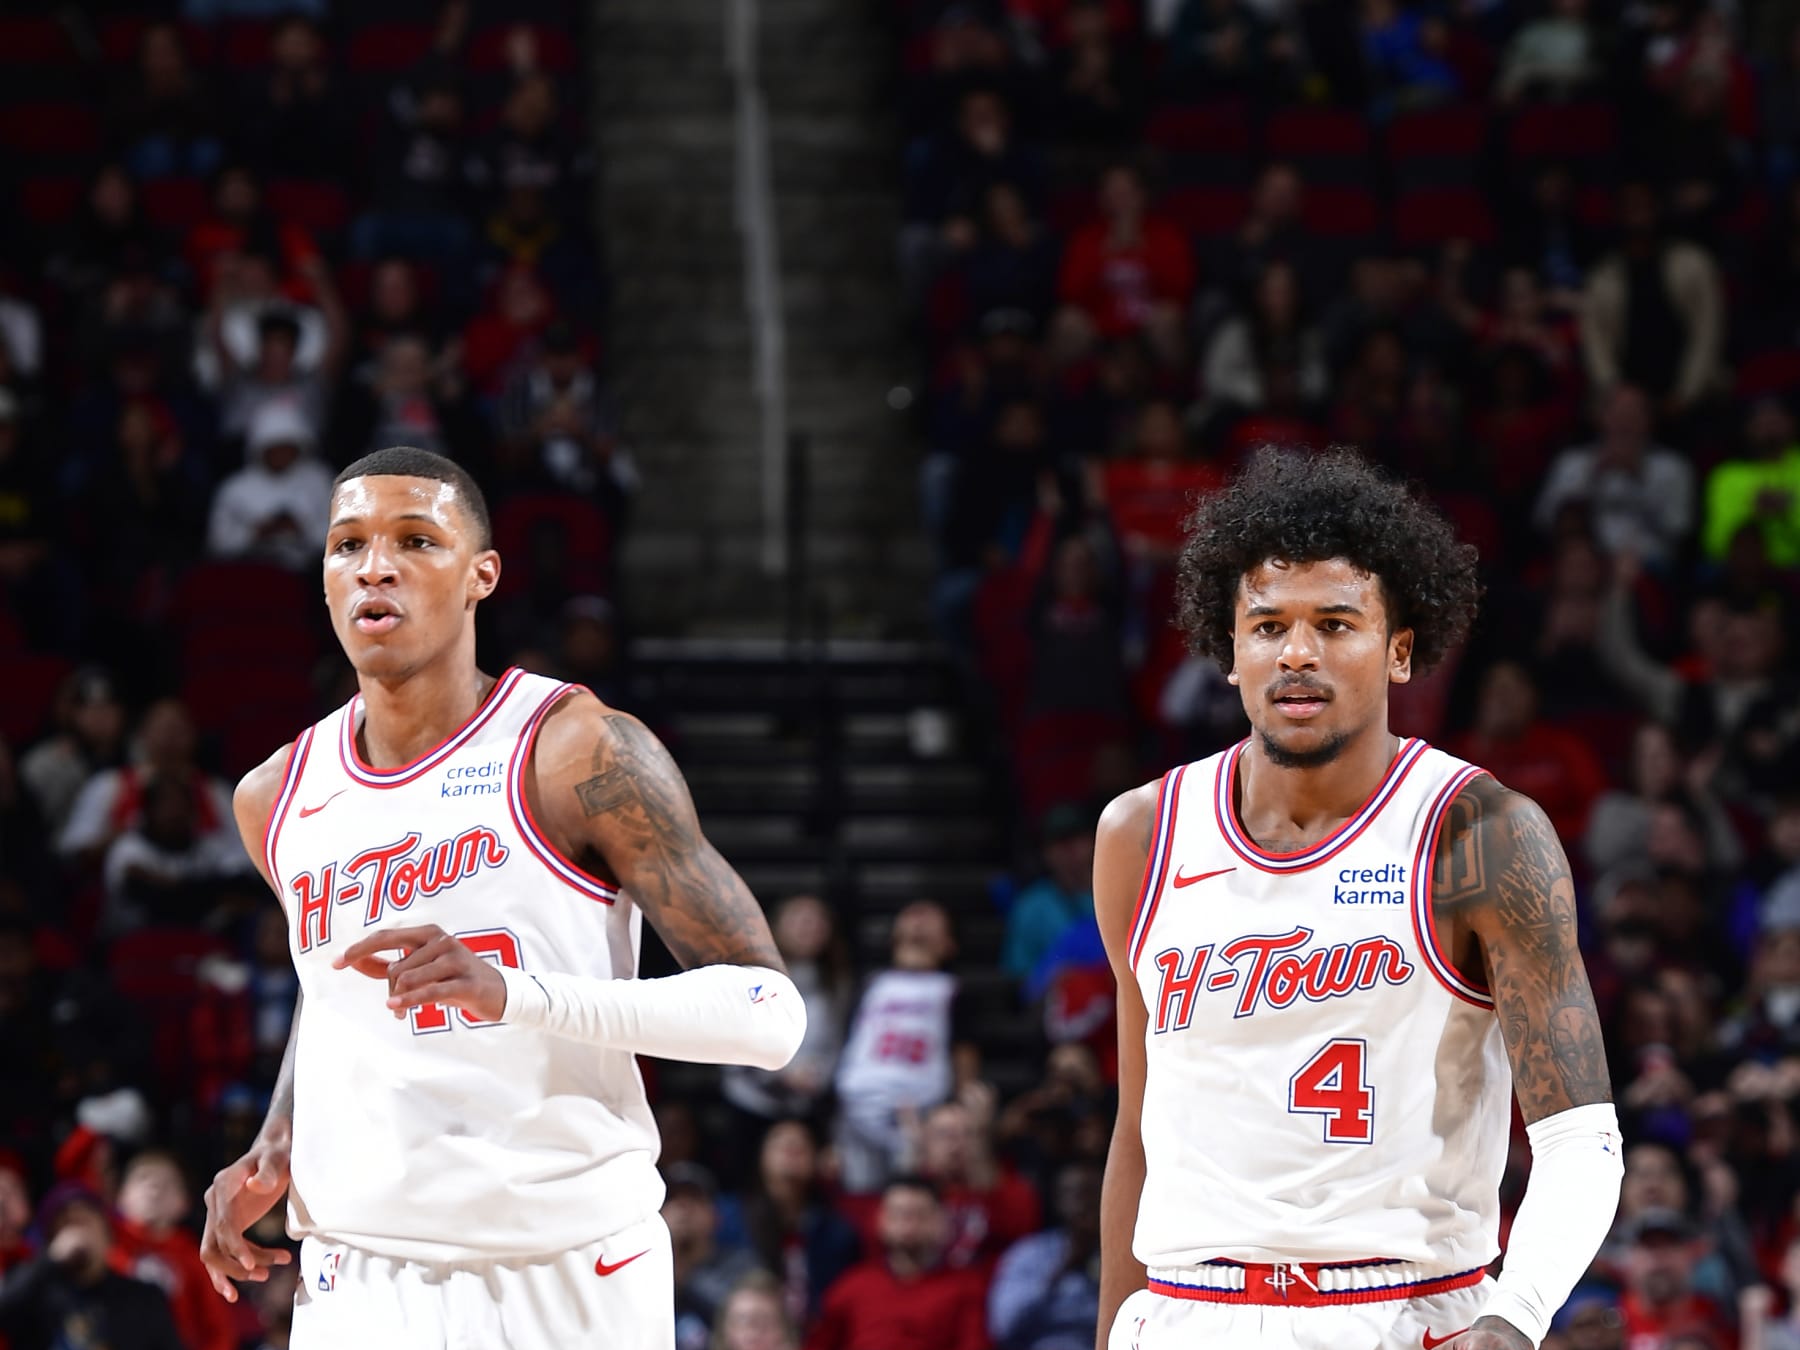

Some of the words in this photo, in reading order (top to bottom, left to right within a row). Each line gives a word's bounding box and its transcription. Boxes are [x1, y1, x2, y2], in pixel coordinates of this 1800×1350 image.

[446, 761, 504, 780] credit
[441, 782, 502, 798] karma
[1339, 863, 1406, 883] credit
[291, 825, 509, 954] H-Town
[1333, 885, 1405, 905] karma
[1155, 925, 1415, 1035] H-Town
[1288, 1038, 1375, 1145] 4
